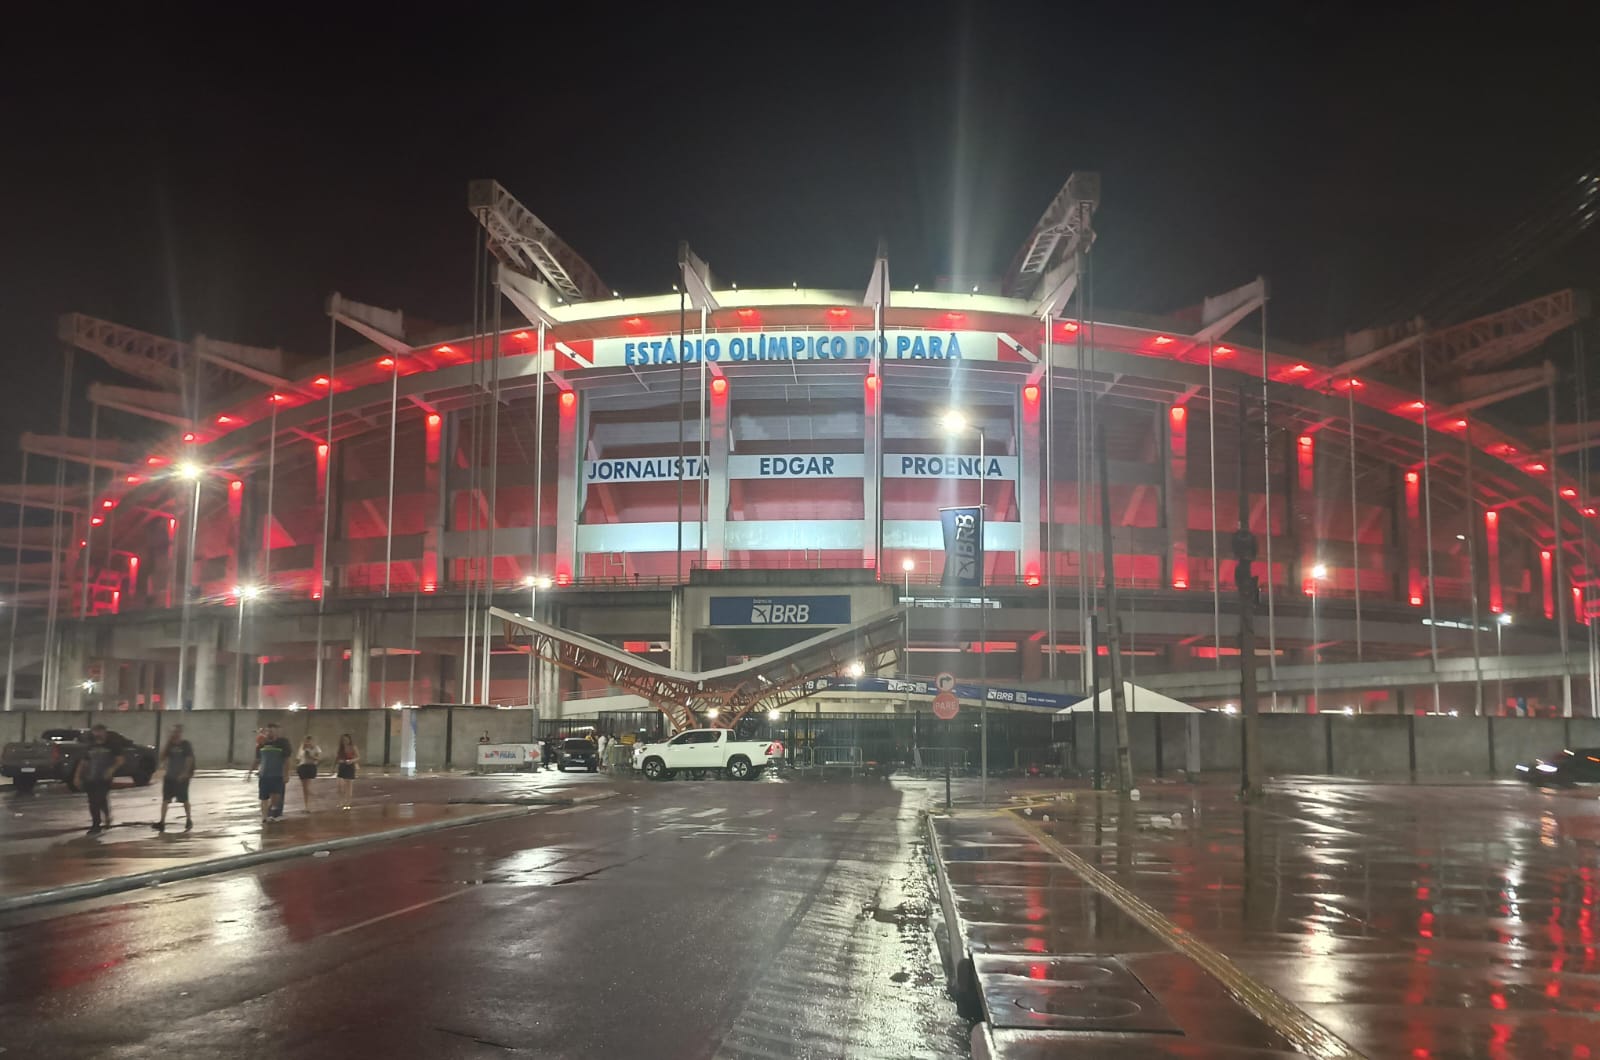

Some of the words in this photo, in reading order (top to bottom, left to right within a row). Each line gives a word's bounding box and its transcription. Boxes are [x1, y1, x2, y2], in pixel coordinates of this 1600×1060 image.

[625, 337, 720, 365] ESTÁDIO
[729, 333, 847, 361] OLÍMPICO
[855, 335, 888, 360] DO
[897, 332, 962, 359] PARÁ
[588, 458, 709, 480] JORNALISTA
[759, 456, 834, 475] EDGAR
[901, 456, 1002, 478] PROENÇA
[955, 514, 975, 556] BRB
[771, 604, 810, 623] BRB
[935, 701, 956, 710] PARE
[996, 691, 1014, 701] BRB
